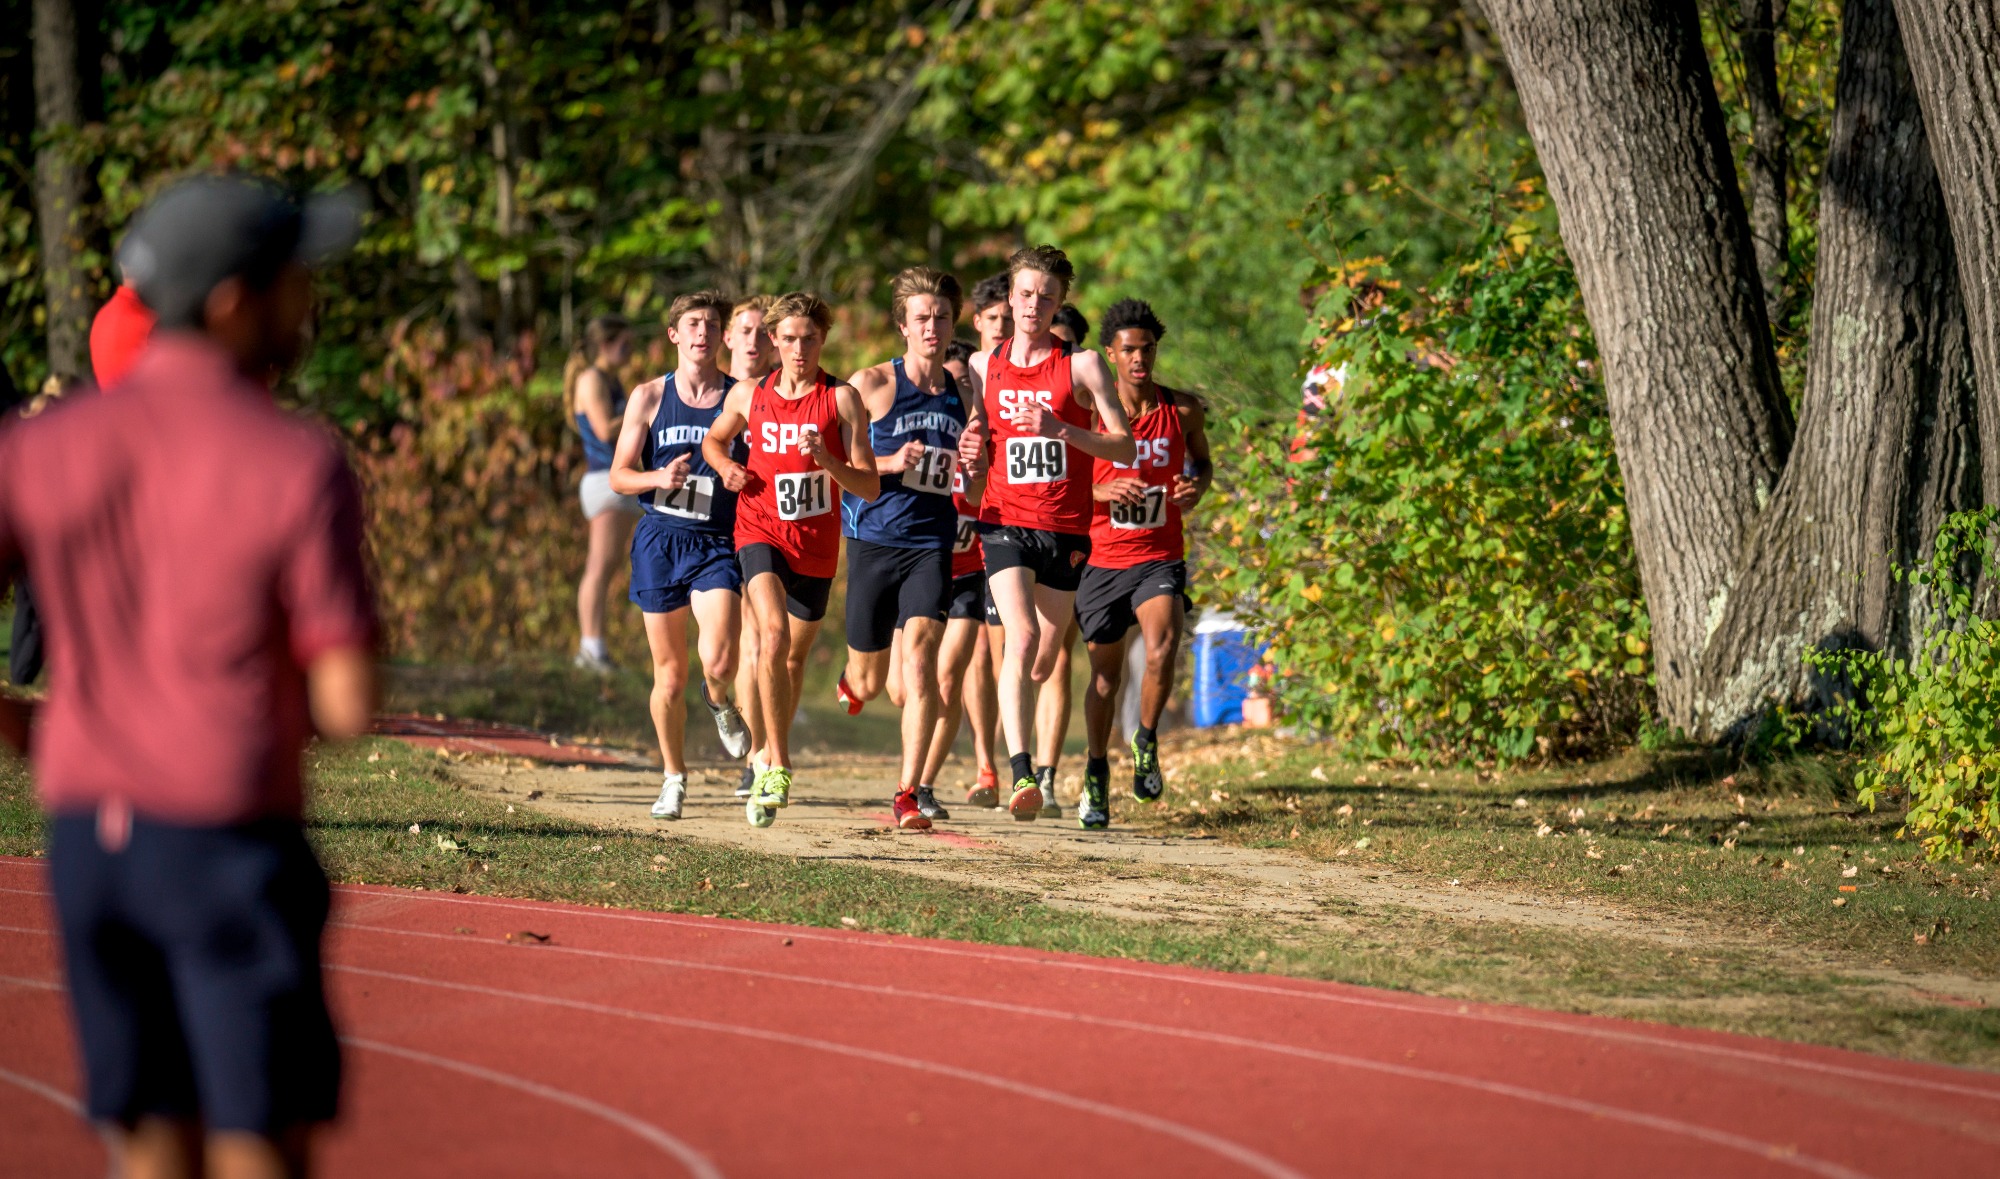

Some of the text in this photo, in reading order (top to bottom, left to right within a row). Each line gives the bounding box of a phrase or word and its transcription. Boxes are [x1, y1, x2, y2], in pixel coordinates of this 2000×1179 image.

[892, 411, 964, 442] ANDOVE
[919, 451, 952, 489] 13
[1009, 441, 1063, 479] 349
[1112, 437, 1170, 469] PS
[665, 479, 698, 513] 21
[778, 474, 826, 515] 341
[1112, 491, 1164, 525] 367
